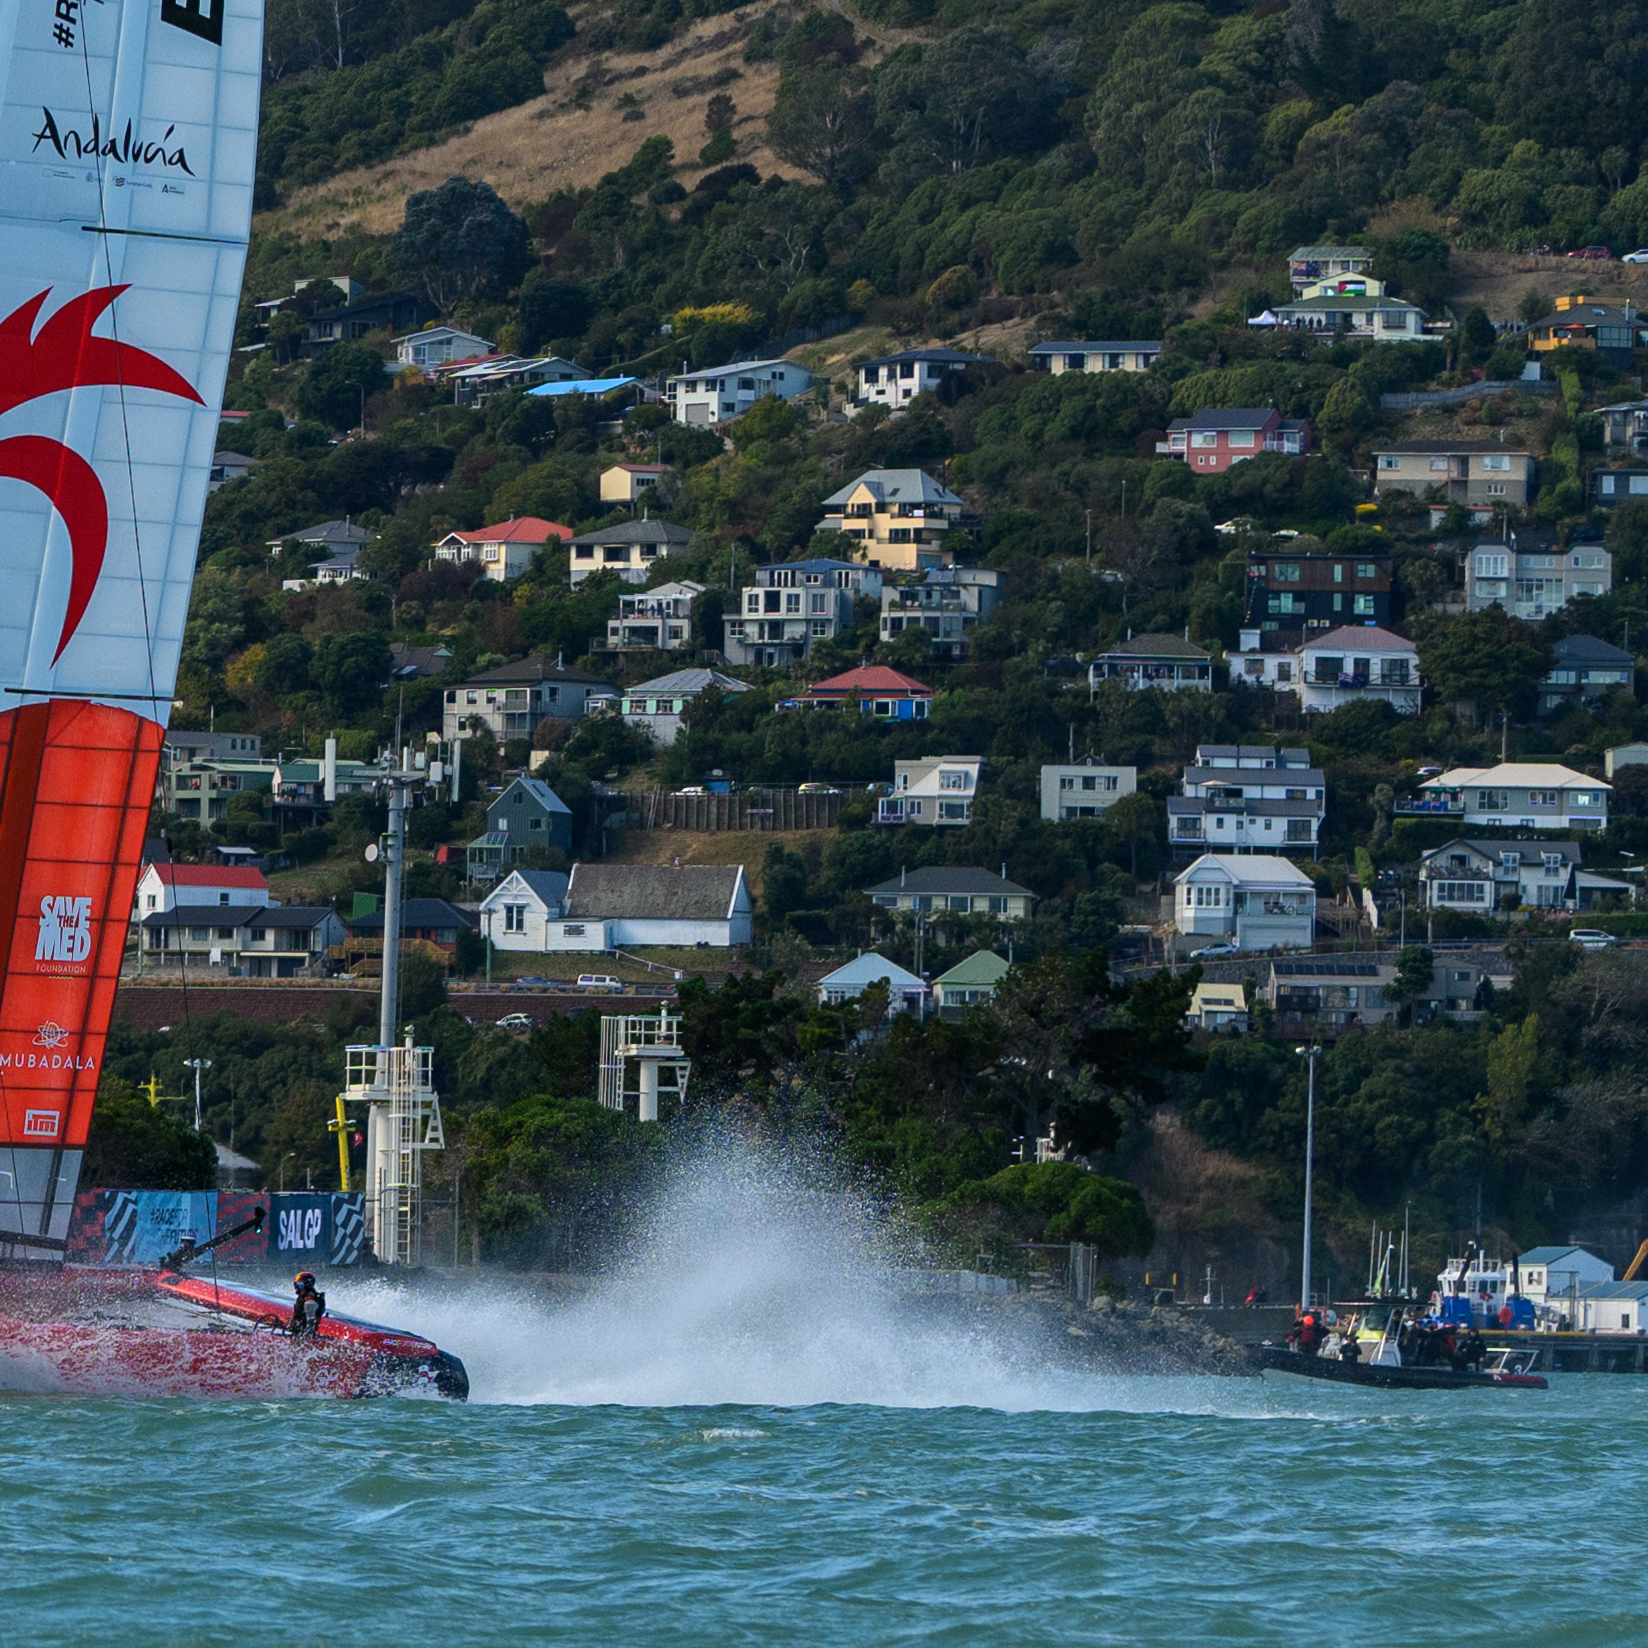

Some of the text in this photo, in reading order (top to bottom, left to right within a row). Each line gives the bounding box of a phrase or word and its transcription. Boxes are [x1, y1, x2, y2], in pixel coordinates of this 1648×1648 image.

[32, 106, 196, 177] Andalucía
[39, 895, 93, 929] SAVE
[35, 926, 91, 962] MED
[36, 963, 86, 974] FOUNDATION
[0, 1053, 95, 1070] MUBADALA
